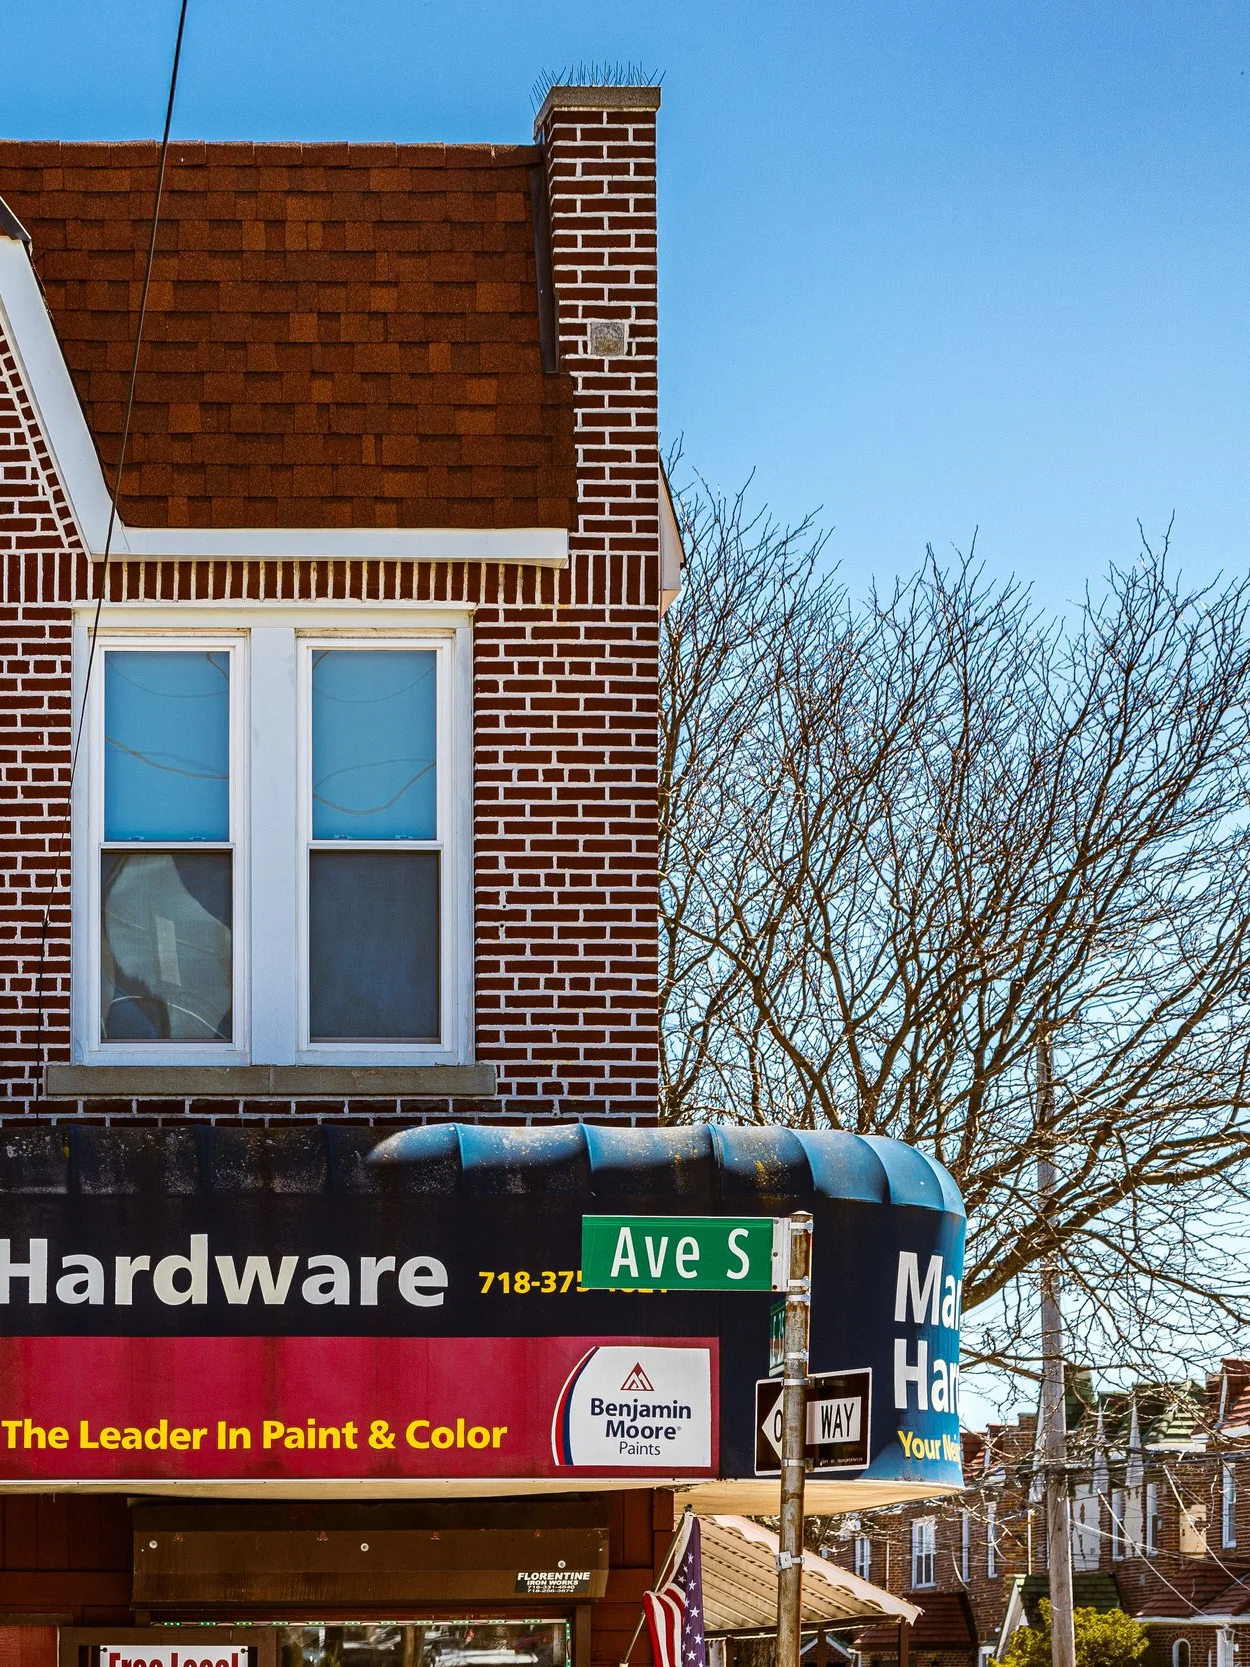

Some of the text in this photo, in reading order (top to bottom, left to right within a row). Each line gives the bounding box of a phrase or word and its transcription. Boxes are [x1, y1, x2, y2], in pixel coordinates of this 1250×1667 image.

[610, 1227, 750, 1280] Ave S
[894, 1338, 961, 1416] Har
[590, 1397, 692, 1424] Benjamin
[821, 1402, 855, 1440] WAY
[1, 1417, 508, 1450] The Leader In Paint & Color
[618, 1440, 662, 1456] Paints
[897, 1430, 942, 1461] Your
[517, 1572, 591, 1580] FLORENTINE
